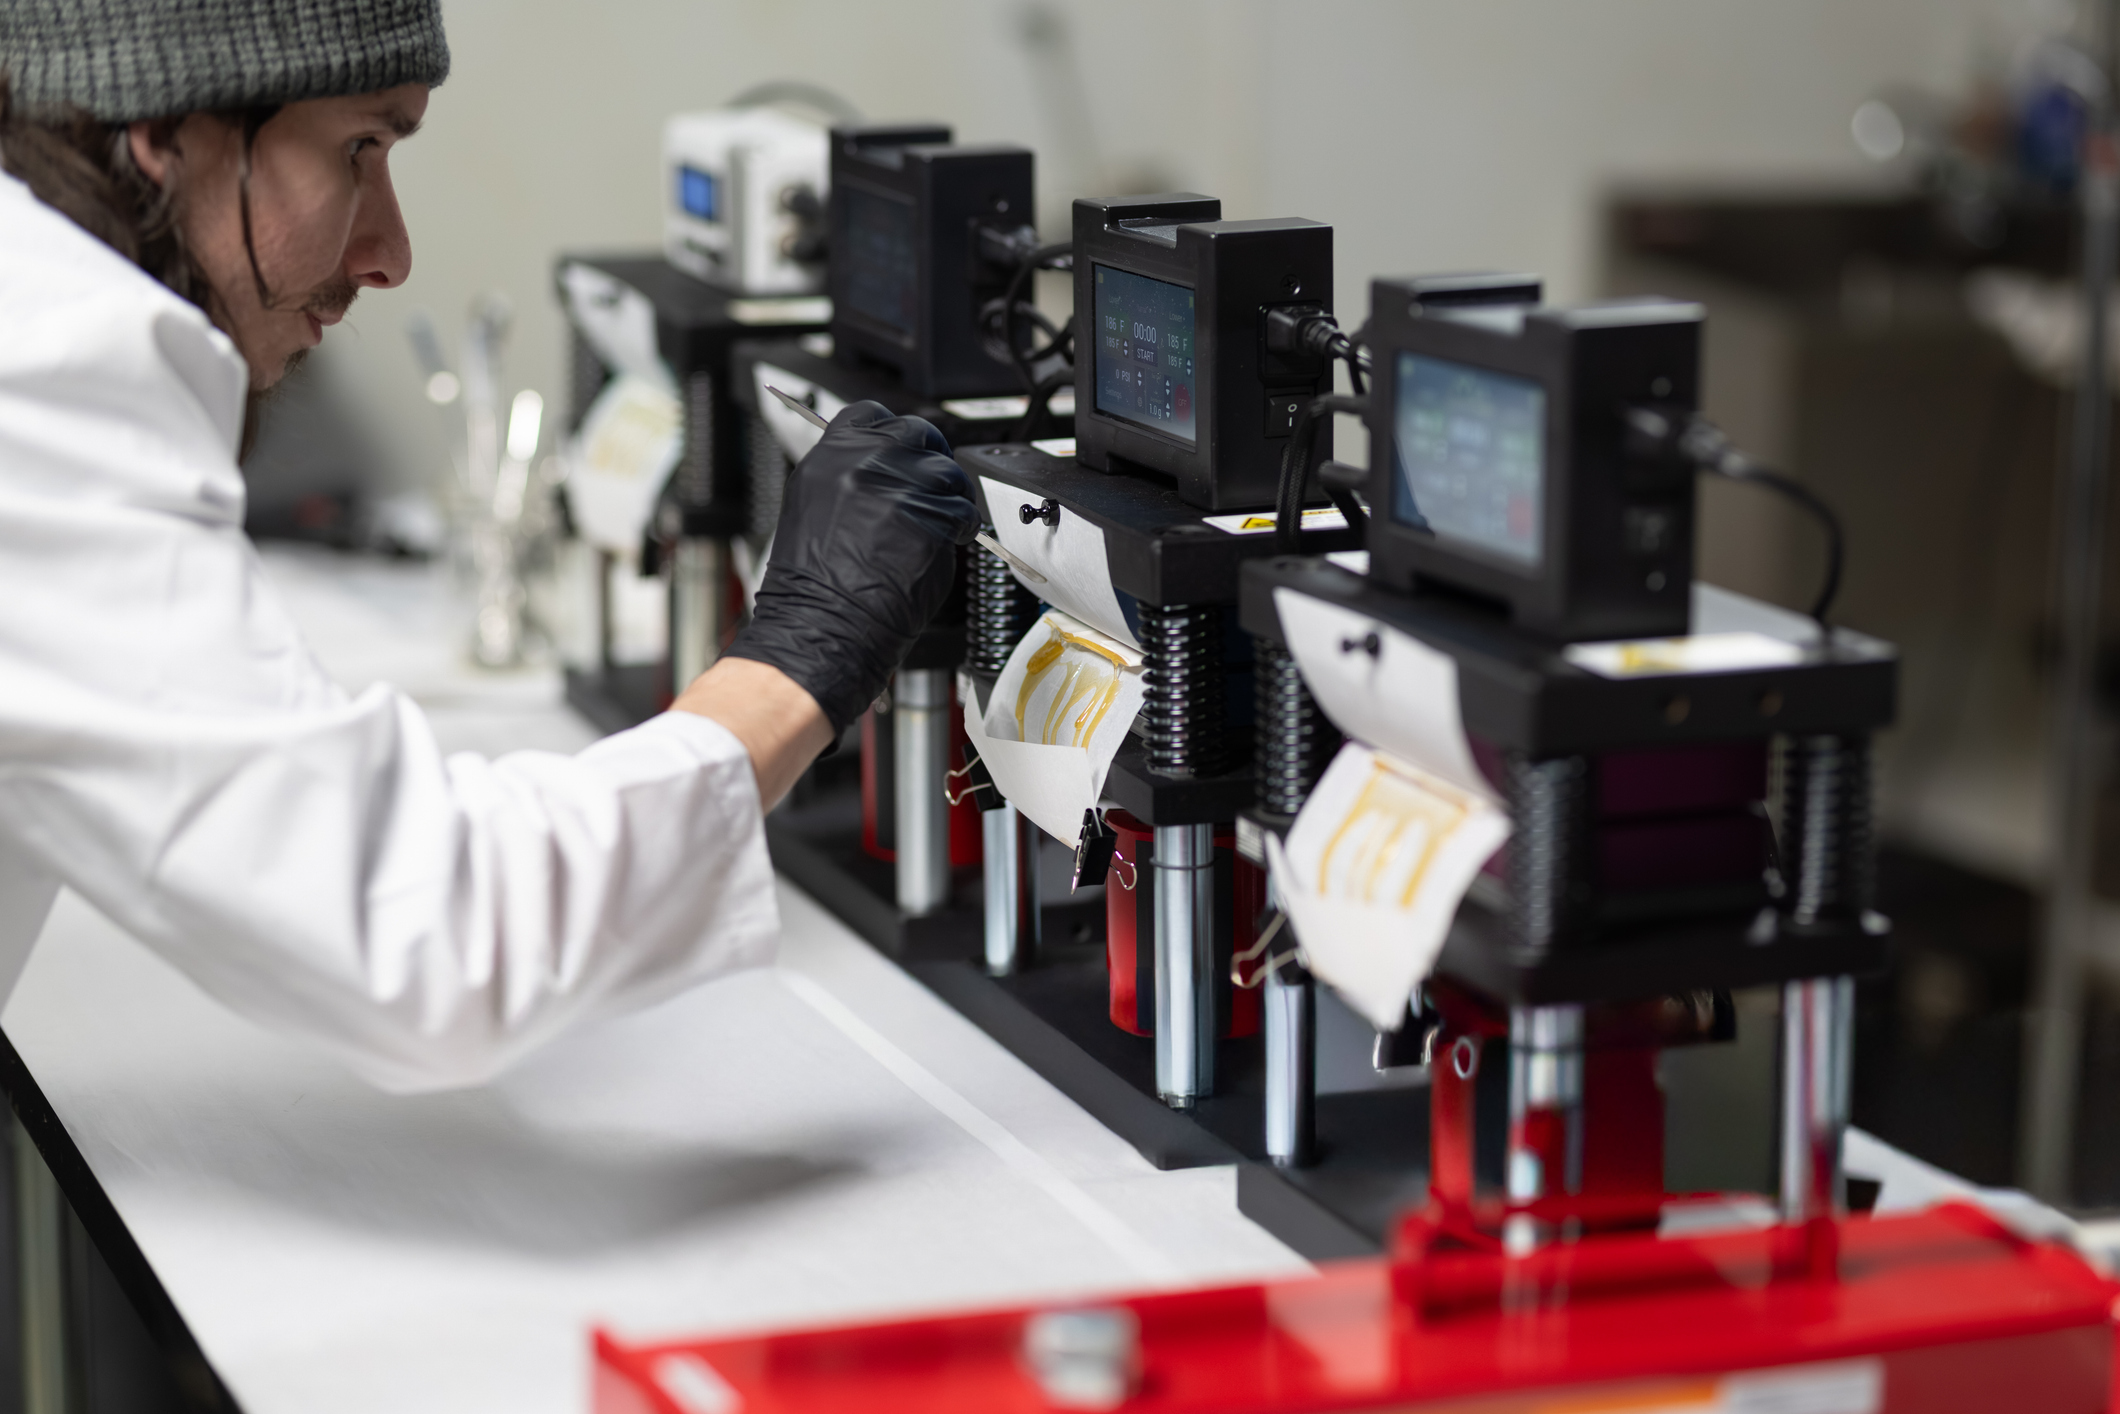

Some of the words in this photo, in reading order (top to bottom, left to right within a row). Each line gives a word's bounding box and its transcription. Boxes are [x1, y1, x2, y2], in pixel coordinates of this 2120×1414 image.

[1105, 316, 1116, 330] 186
[1120, 320, 1124, 332] F
[1134, 322, 1156, 344] 00:00
[1106, 336, 1115, 348] 185
[1168, 334, 1179, 349] 185
[1183, 338, 1187, 351] F
[1137, 348, 1154, 362] START
[1168, 355, 1178, 367] 185
[1179, 358, 1182, 368] F
[1122, 370, 1131, 382] PSI
